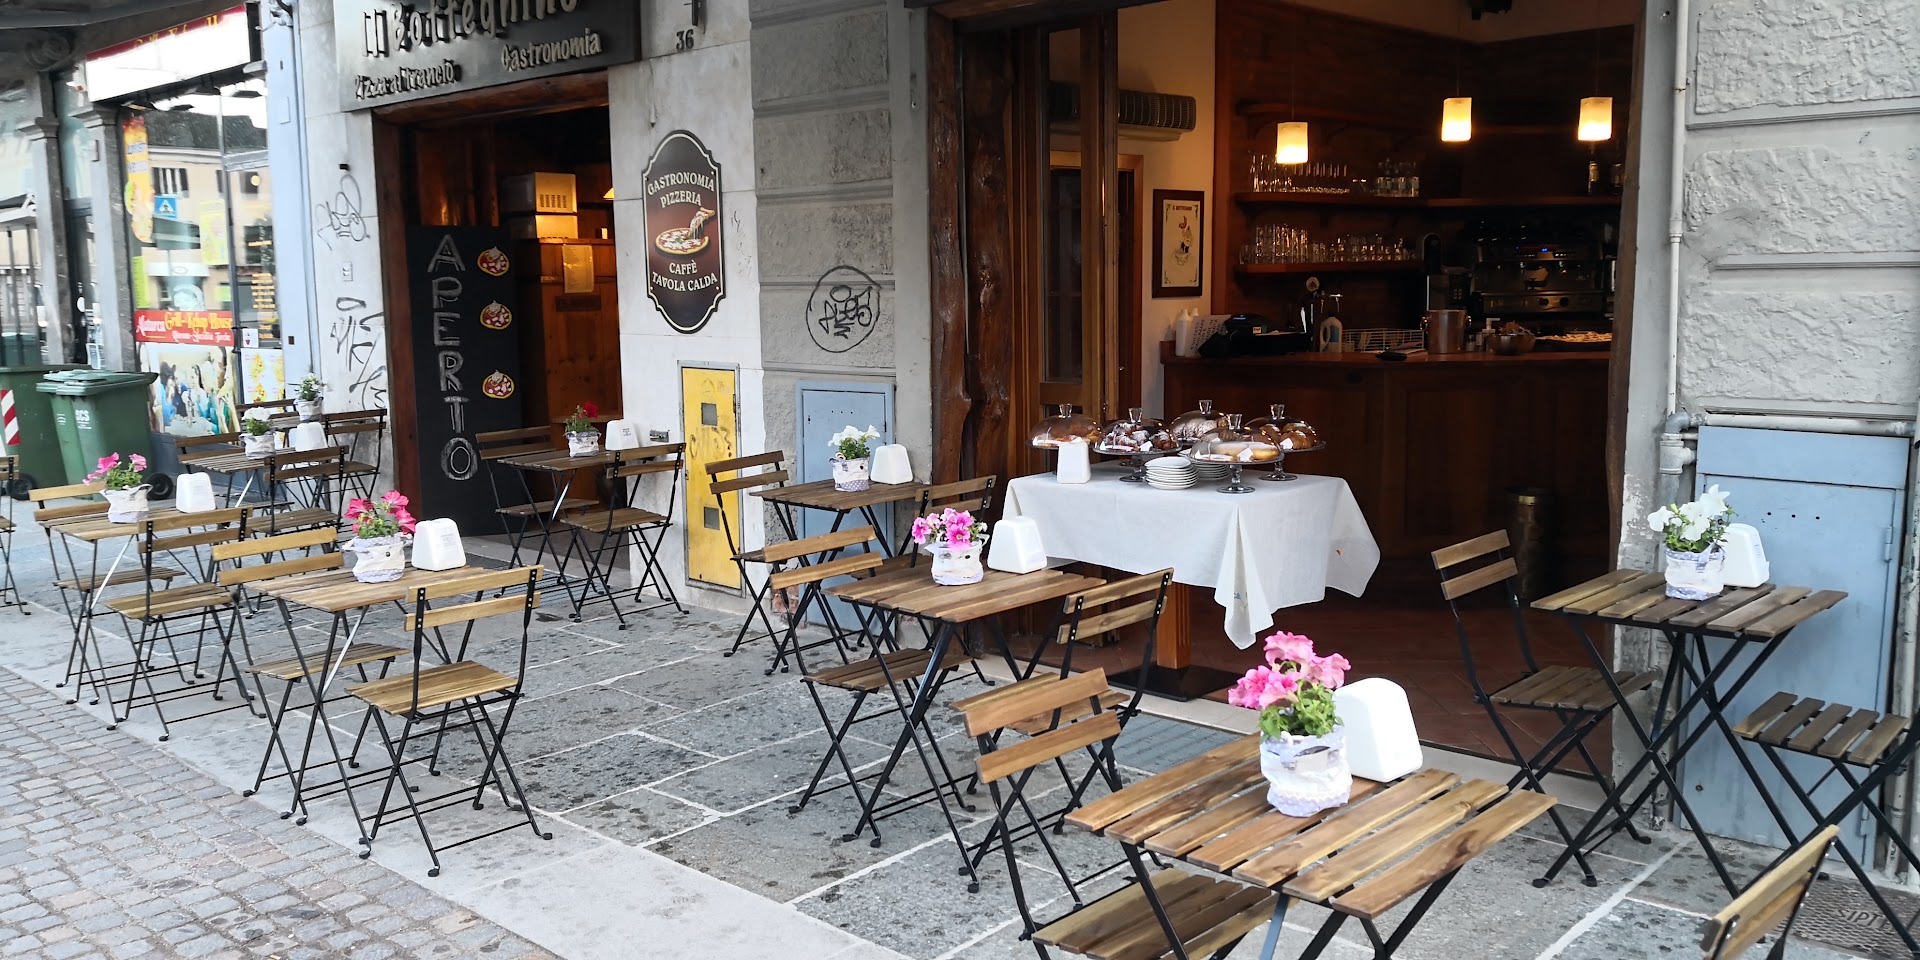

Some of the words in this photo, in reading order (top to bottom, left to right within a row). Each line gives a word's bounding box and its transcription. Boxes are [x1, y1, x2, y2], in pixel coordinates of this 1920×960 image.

[501, 28, 601, 71] Gastronomia
[676, 28, 695, 53] 36
[648, 171, 715, 196] GASTRONOMIA
[660, 190, 702, 208] PIZZERIA
[669, 259, 698, 275] CAFFÈ
[652, 271, 686, 292] TAVOLA
[687, 272, 718, 292] CALDA
[427, 234, 478, 481] APERTO
